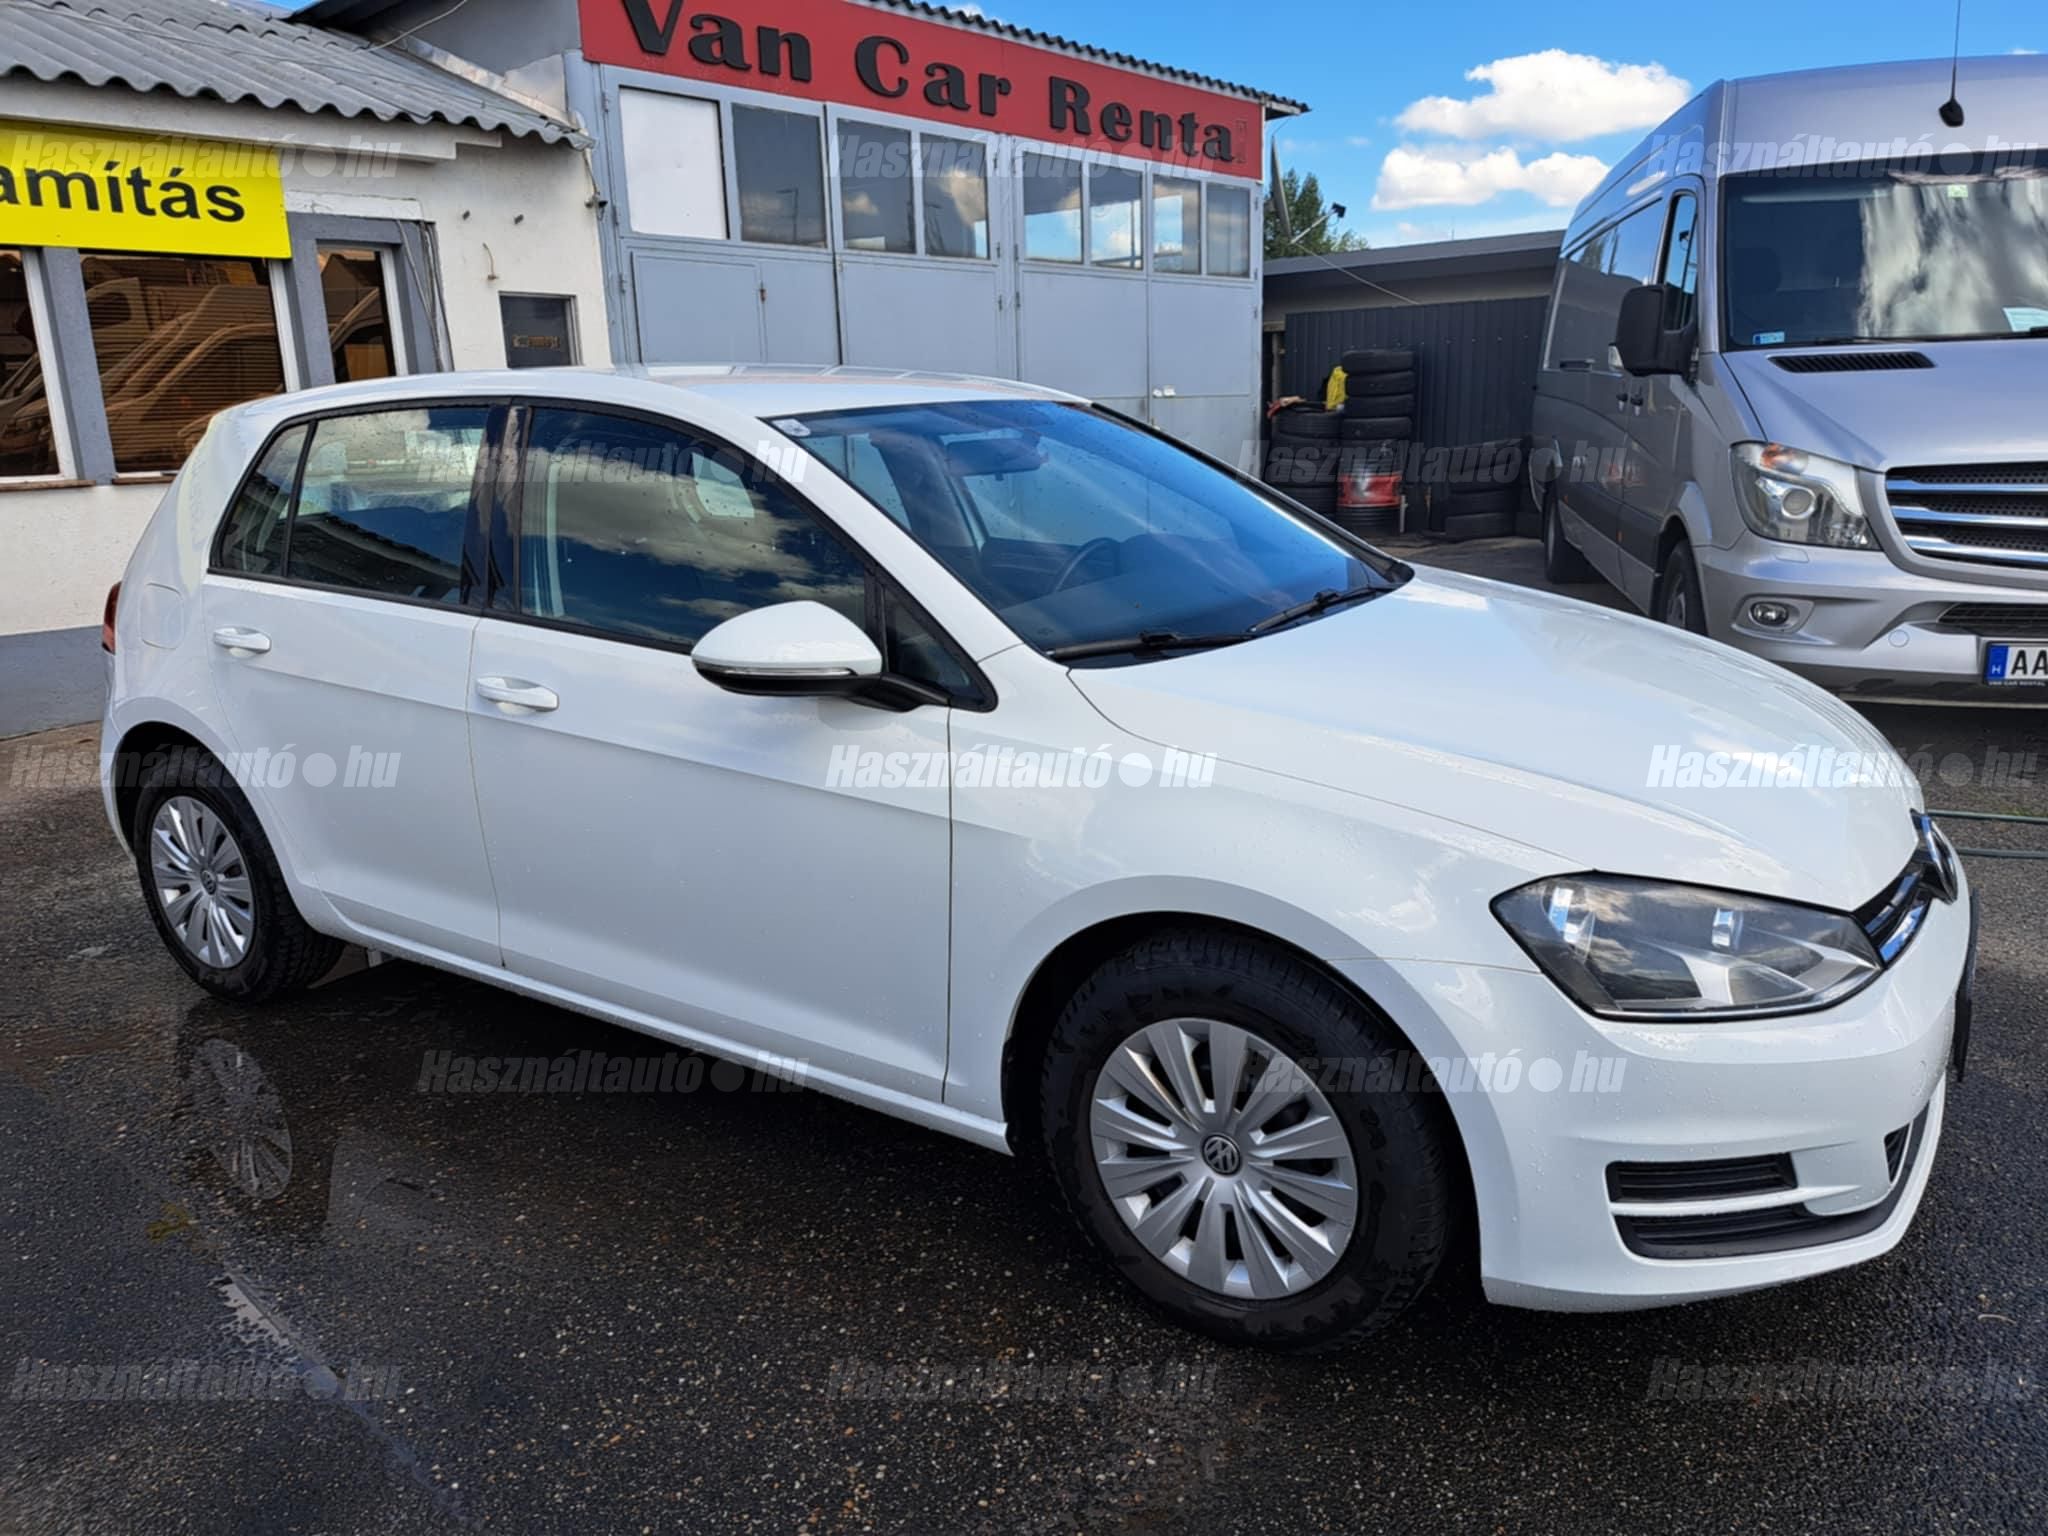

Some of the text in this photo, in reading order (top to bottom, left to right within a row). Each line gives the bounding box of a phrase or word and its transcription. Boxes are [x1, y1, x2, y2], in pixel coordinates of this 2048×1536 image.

[621, 0, 1234, 162] Van Car Renta
